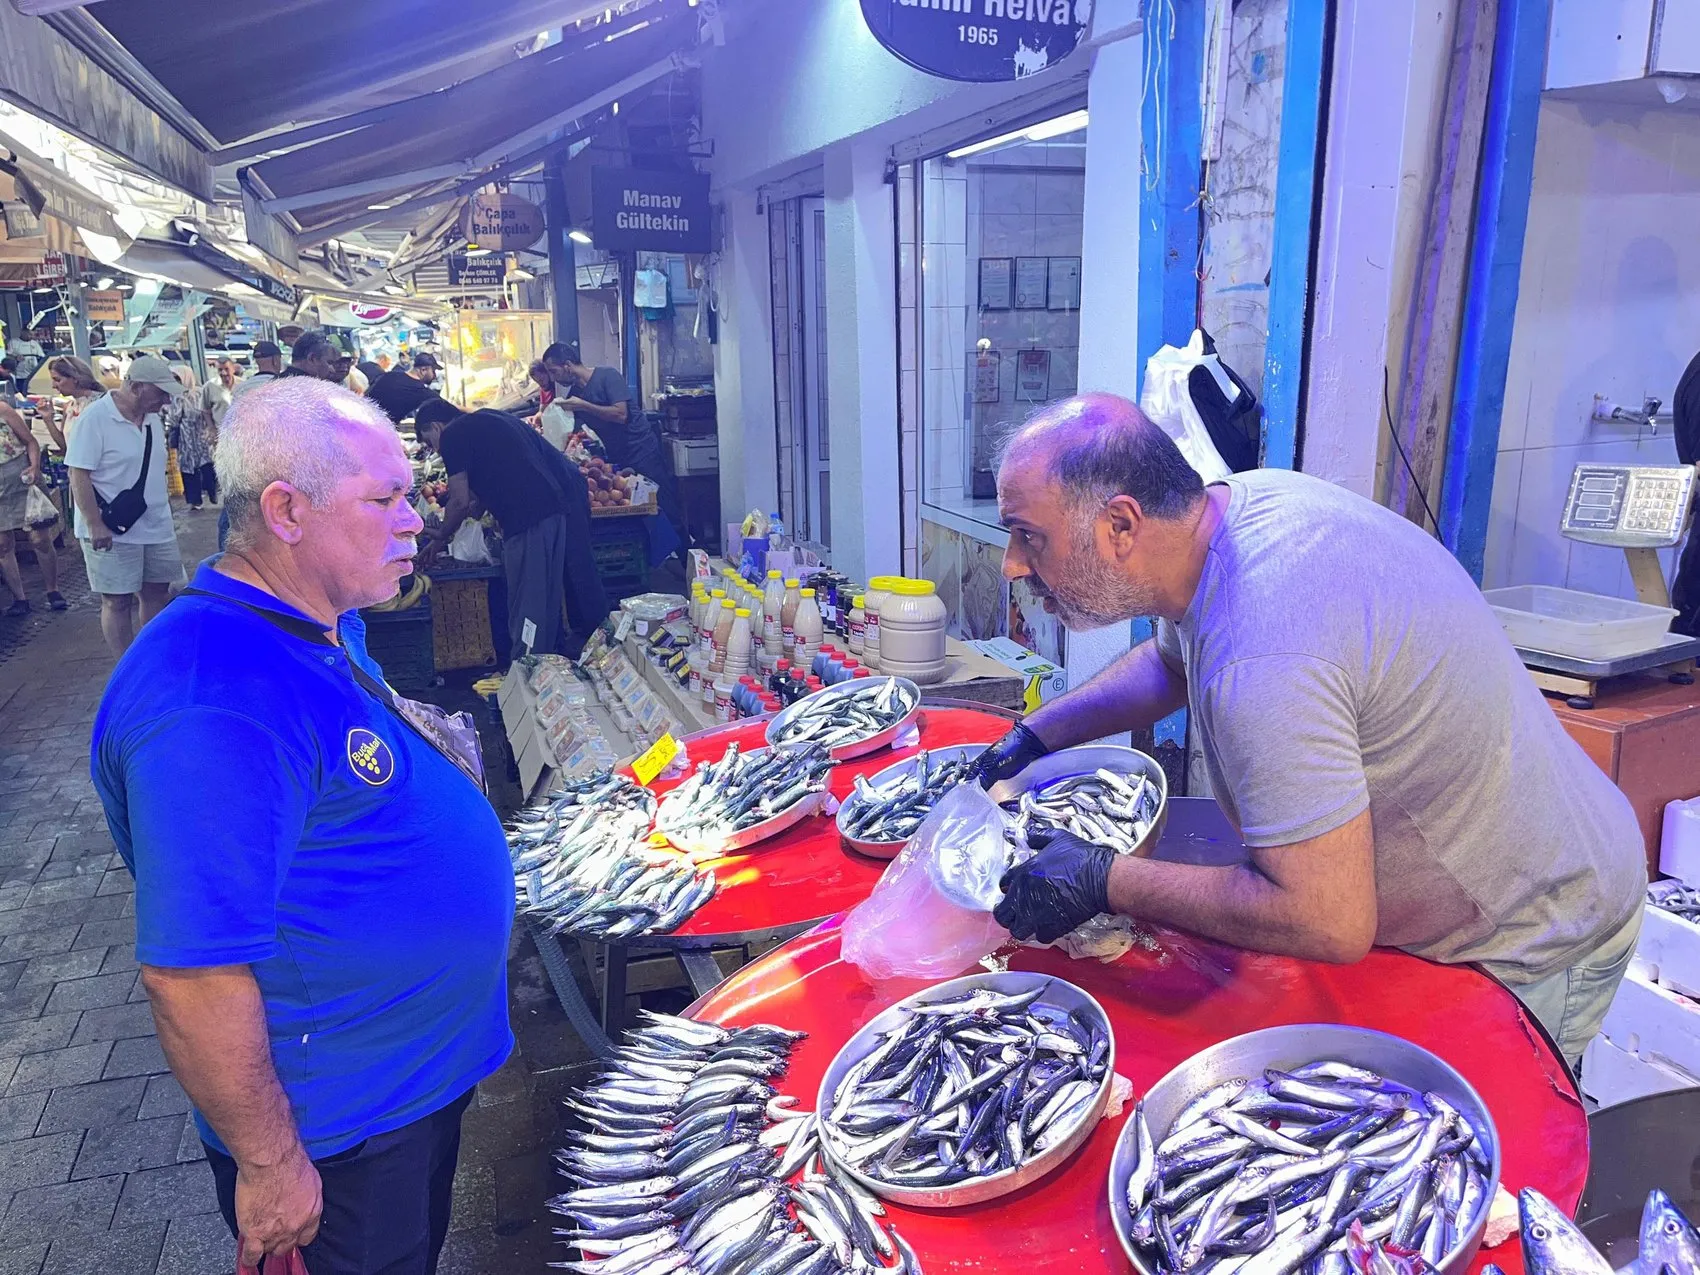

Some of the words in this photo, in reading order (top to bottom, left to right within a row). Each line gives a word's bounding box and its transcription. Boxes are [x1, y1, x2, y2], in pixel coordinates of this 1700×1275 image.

[958, 25, 998, 45] 1965
[623, 189, 682, 209] Manav
[485, 207, 516, 222] Çapa
[616, 211, 689, 232] Gültekin
[473, 223, 531, 237] Balıkçılık
